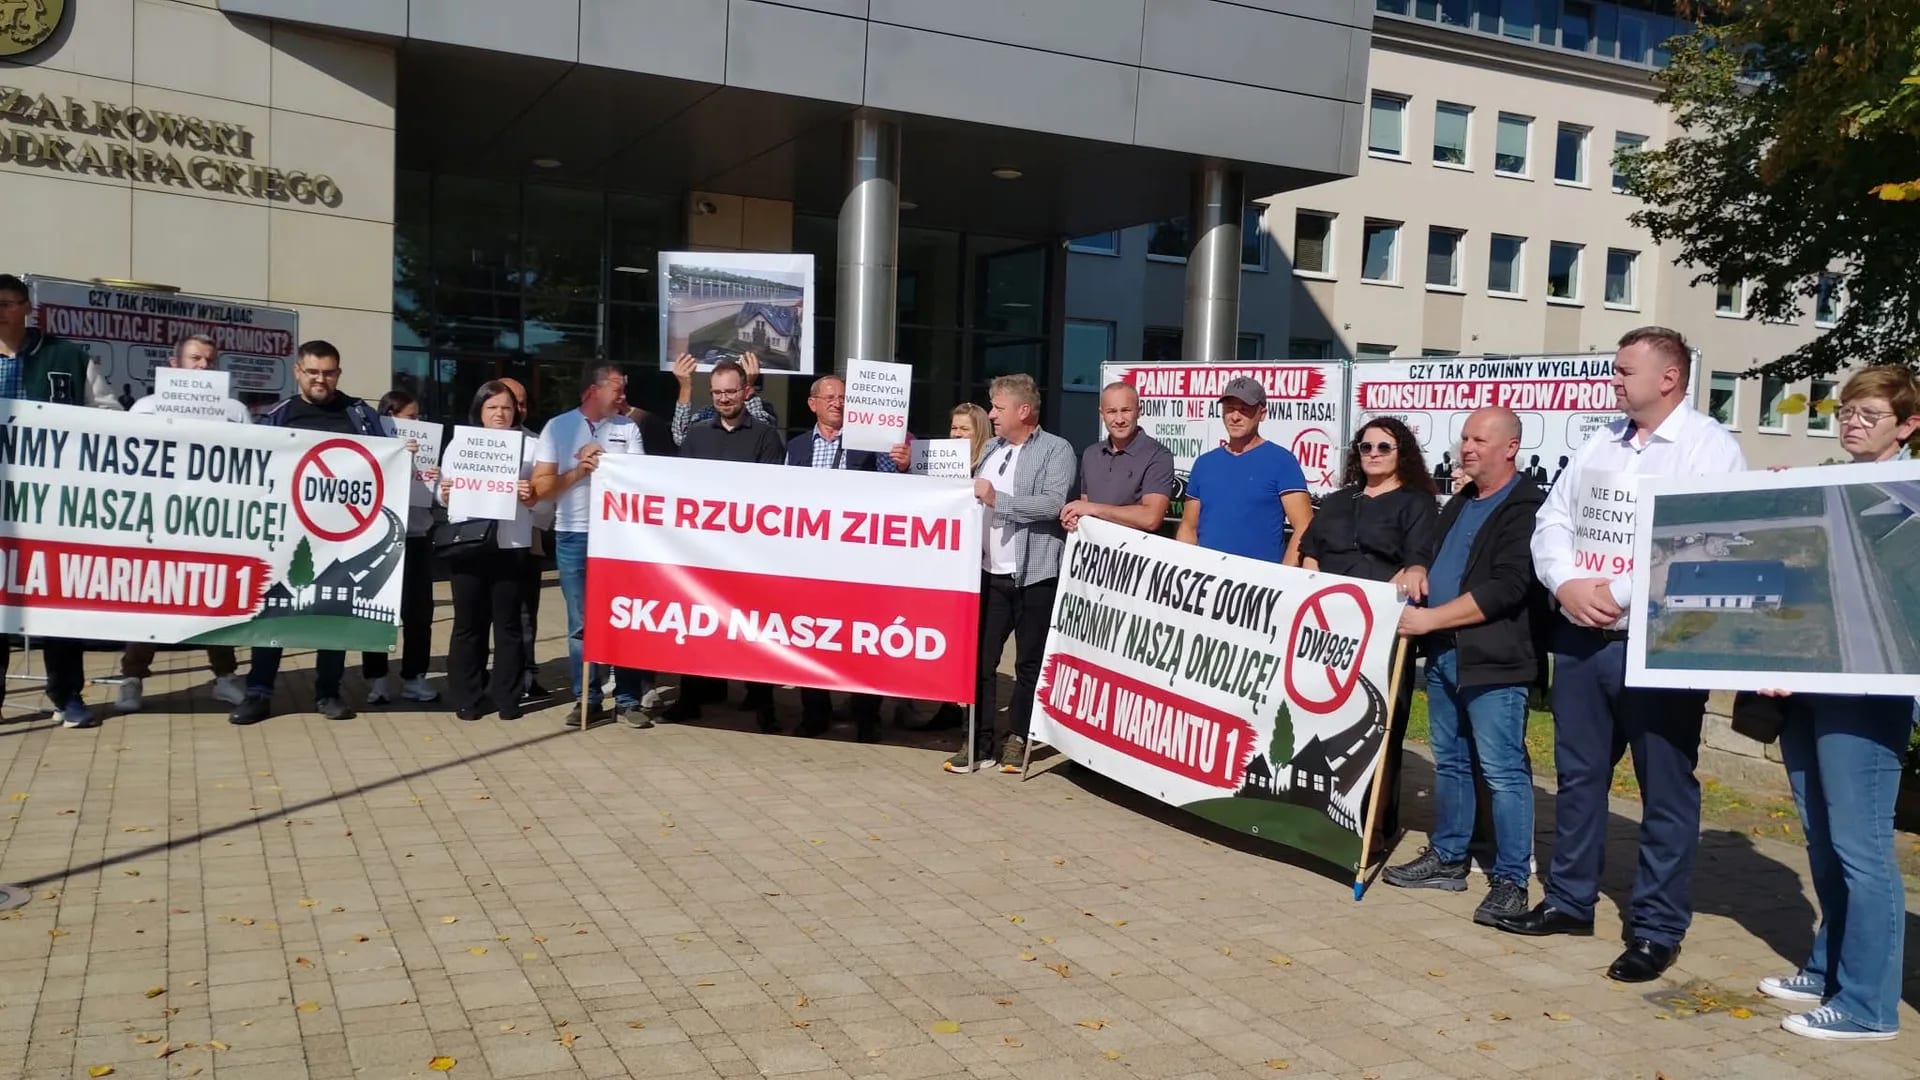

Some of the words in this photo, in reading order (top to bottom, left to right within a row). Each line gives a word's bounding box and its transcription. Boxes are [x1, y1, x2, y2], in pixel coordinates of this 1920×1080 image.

[89, 290, 112, 308] CZY
[116, 293, 139, 311] TAK
[141, 296, 195, 317] POWINNY
[45, 306, 164, 344] KONSULTACJE
[859, 370, 877, 380] NIE
[878, 372, 897, 383] DLA
[1409, 364, 1434, 380] CZY
[1439, 364, 1463, 380] TAK
[1469, 362, 1532, 379] POWINNY
[170, 378, 188, 389] NIE
[191, 380, 213, 390] DLA
[851, 382, 904, 396] OBECNYCH
[1135, 370, 1185, 396] PANIE
[161, 391, 221, 403] OBECNYCH
[846, 395, 908, 409] WARIANTÓW
[1366, 383, 1494, 410] KONSULTACJE
[155, 403, 226, 416] WARIANTÓW
[847, 410, 875, 425] DW
[877, 413, 905, 428] 985
[1171, 400, 1183, 418] TO
[1187, 400, 1204, 419] NIE
[1296, 402, 1336, 421] TRASA!
[409, 430, 428, 439] DLA
[1155, 423, 1187, 436] CHCEMY
[467, 437, 485, 447] NIE
[487, 439, 507, 449] DLA
[79, 432, 177, 480] NASZE
[188, 444, 275, 493] DOMY,
[459, 449, 513, 462] OBECNYCH
[921, 449, 938, 458] NIE
[939, 449, 958, 458] DLA
[1299, 441, 1329, 469] NIE
[453, 461, 517, 475] WARIANTÓW
[916, 461, 965, 471] OBECNYCH
[304, 476, 373, 507] DW985
[455, 477, 481, 491] DW
[487, 480, 515, 494] 985
[1591, 487, 1609, 501] NIE
[1614, 490, 1637, 503] DL
[0, 480, 51, 525] MY
[59, 485, 154, 543] NASZĄ
[164, 494, 287, 552] OKOLICĘ!
[602, 490, 665, 527] NIE
[674, 497, 831, 541] RZUCIM
[840, 511, 962, 551] ZIEMI
[1582, 505, 1634, 524] OBECNY
[1575, 549, 1605, 572] DW
[59, 552, 228, 609] WARIANTU
[236, 566, 250, 610] 1
[1070, 539, 1150, 600] CHROŃMY
[1150, 561, 1215, 617] NASZE
[1211, 578, 1283, 644] DOMY,
[608, 595, 719, 645] SKĄD
[727, 608, 842, 652] NASZ
[851, 615, 947, 661] RÓD
[1057, 591, 1127, 653] CHROŃMY
[1122, 614, 1185, 687] NASZĄ
[1184, 633, 1281, 715] OKOLICĘ!
[1296, 625, 1359, 671] DW985
[1049, 662, 1078, 712] NIE
[1074, 675, 1109, 732] DLA
[1112, 687, 1220, 774] WARIANTU
[1224, 726, 1240, 781] 1
